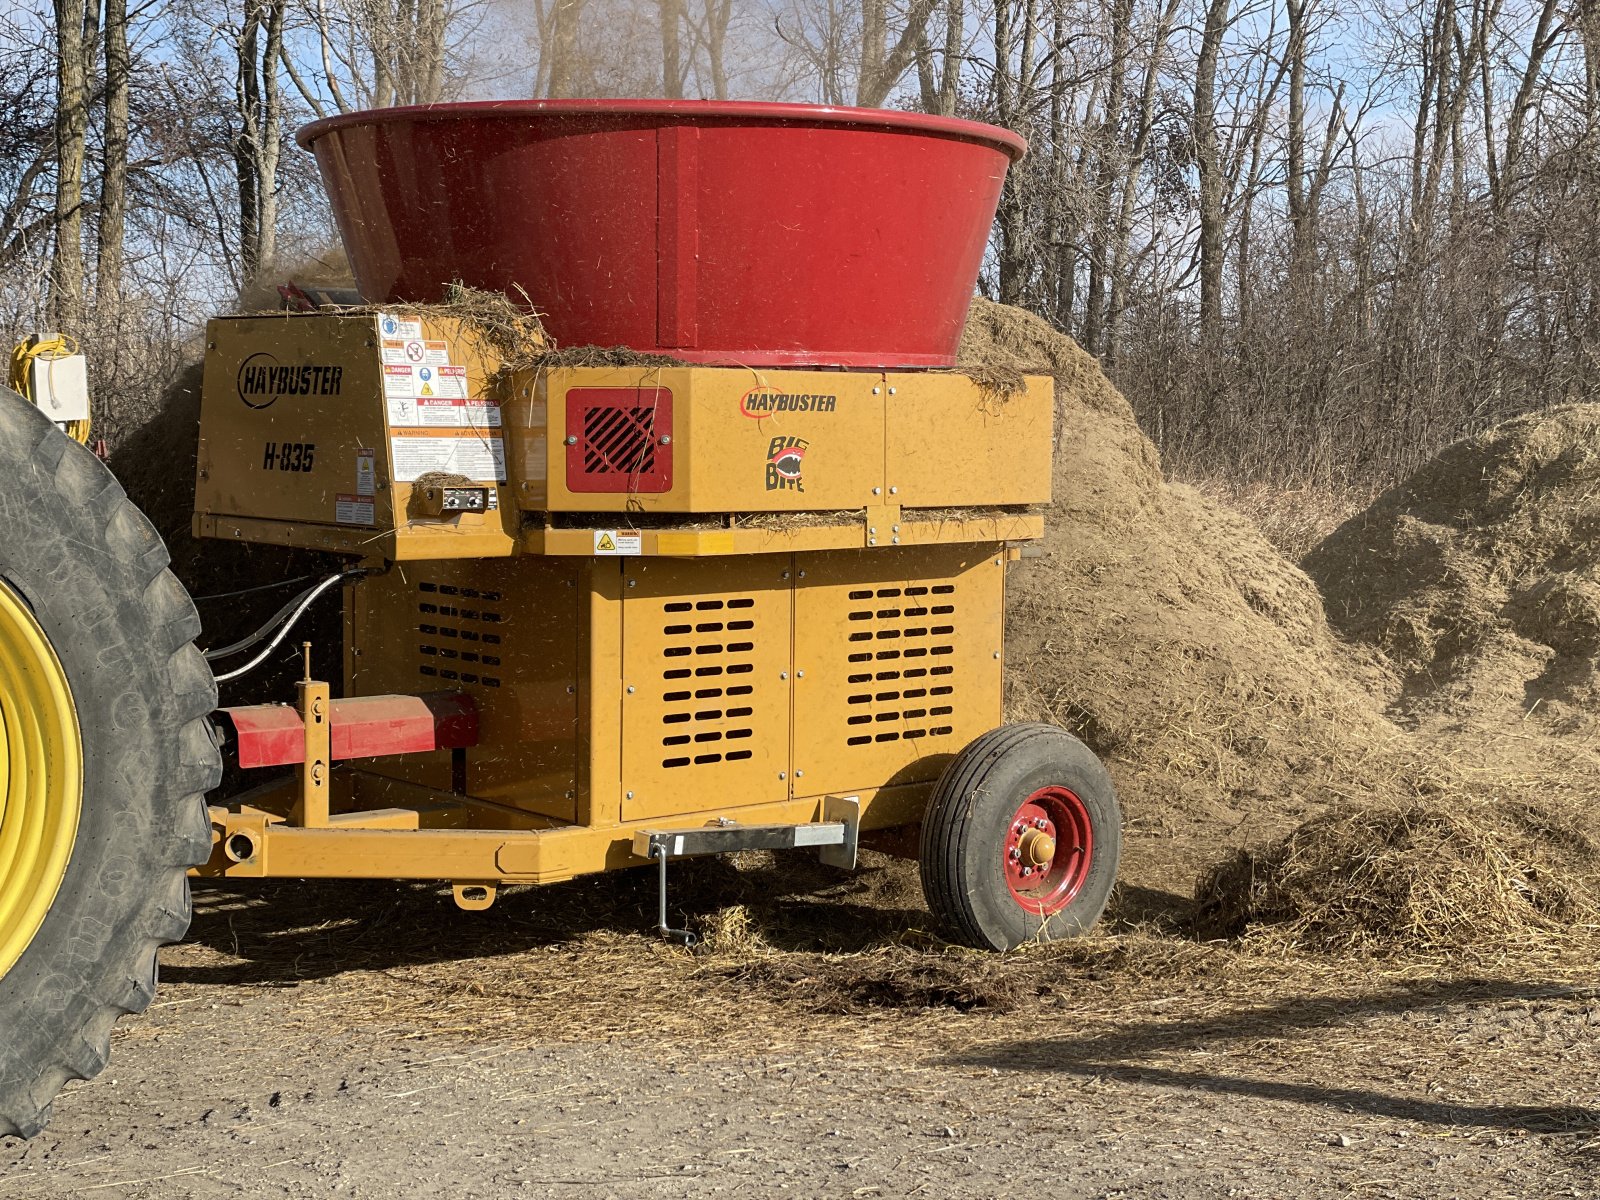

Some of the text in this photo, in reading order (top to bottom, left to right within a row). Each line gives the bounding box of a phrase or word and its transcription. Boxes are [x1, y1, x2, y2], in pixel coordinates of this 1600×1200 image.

[243, 366, 343, 395] HAYBUSTER
[391, 365, 412, 374] DANGER
[746, 393, 837, 412] HAYBUSTER
[263, 442, 315, 472] H-835
[767, 435, 810, 460] BIG
[765, 462, 805, 493] BITE
